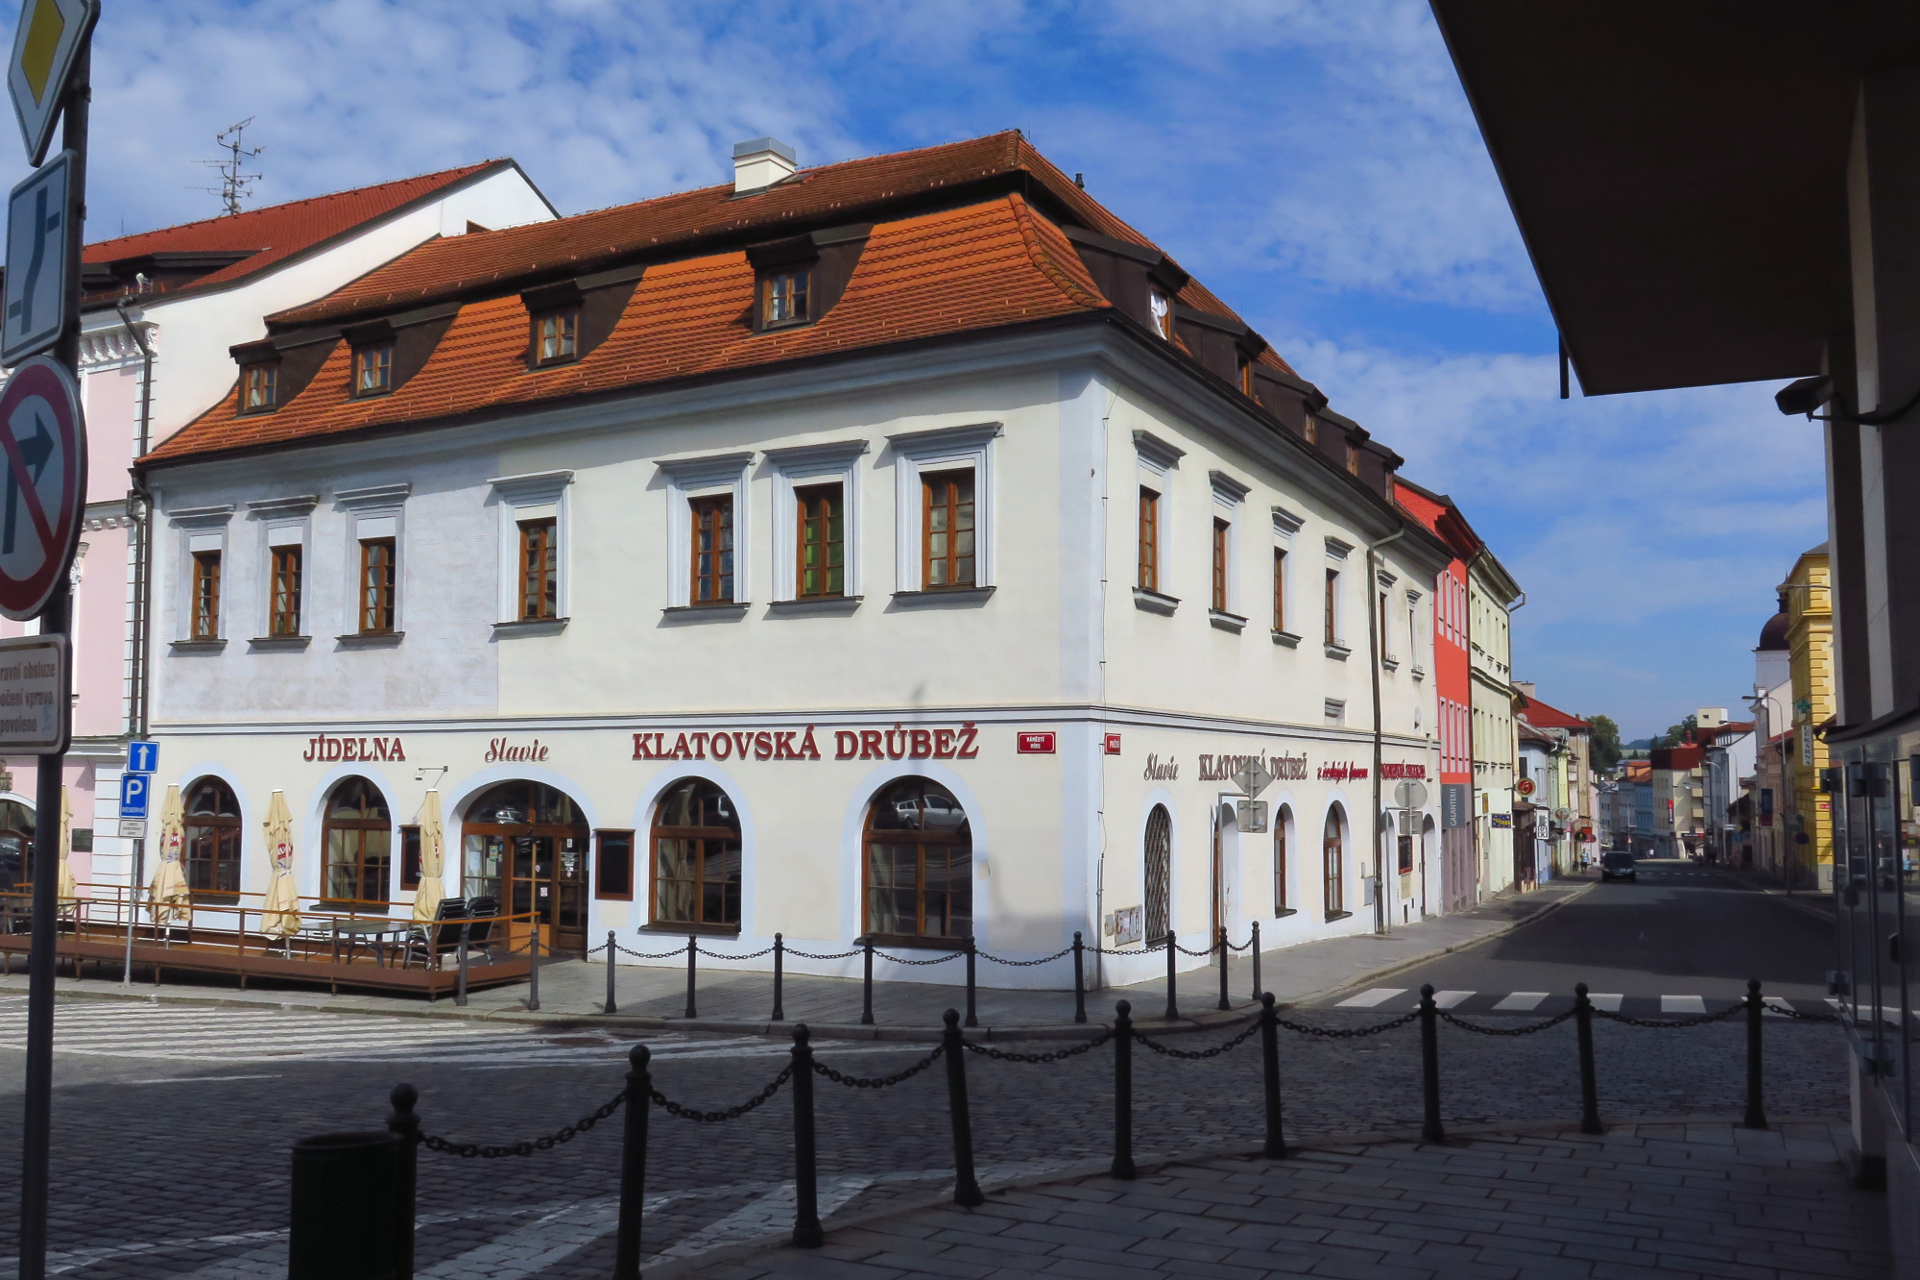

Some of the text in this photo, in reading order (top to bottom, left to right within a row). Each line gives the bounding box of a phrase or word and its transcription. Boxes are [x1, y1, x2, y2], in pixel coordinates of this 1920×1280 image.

[0, 661, 56, 680] ravní obsluze
[0, 688, 54, 709] očení vpravo
[303, 733, 406, 762] JÍDELNA
[484, 737, 550, 762] Slavie
[632, 721, 980, 761] KLATOVSKÁ DRŮBEŽ
[1143, 752, 1180, 781] Slavie
[1198, 748, 1309, 781] KLATOVÁ DRŮBEŽ
[125, 779, 143, 804] P
[1449, 787, 1457, 827] GALANTERIE
